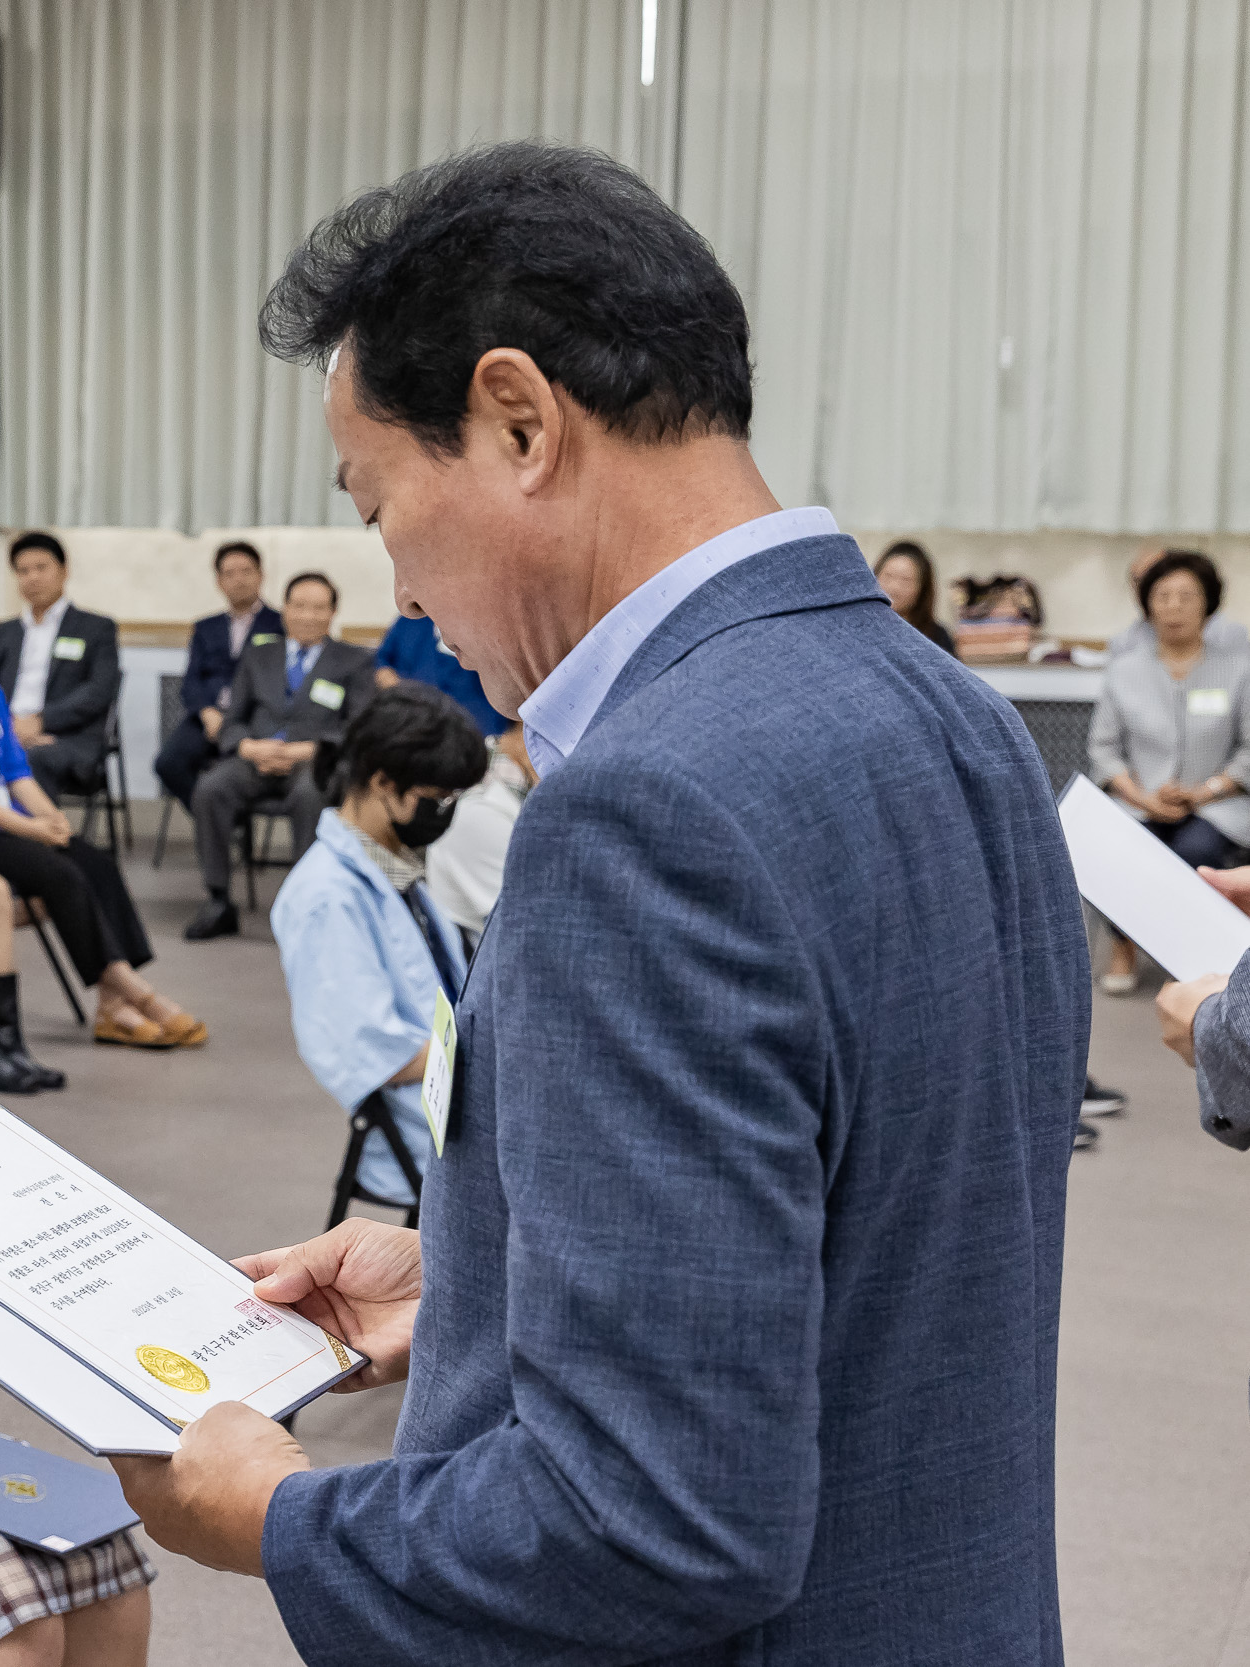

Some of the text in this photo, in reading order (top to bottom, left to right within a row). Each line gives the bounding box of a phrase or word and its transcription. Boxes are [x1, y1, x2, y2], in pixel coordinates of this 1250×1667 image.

[0, 1245, 26, 1258] 학생은
[21, 1238, 39, 1249] 평소
[35, 1231, 55, 1242] 바른
[49, 1221, 74, 1236] 품행과
[70, 1210, 100, 1227] 모범적인
[94, 1204, 112, 1214] 학교
[8, 1218, 132, 1280] 생활로 타의 귀감이 되었기에 2023년도
[28, 1231, 153, 1295] 광진구 장학기금 장학생으로 선정하여 이
[50, 1277, 113, 1310] 증서를 수여합니다.
[131, 1286, 184, 1317] 2023년 8월 24일
[192, 1314, 271, 1361] 광진구장학위원회
